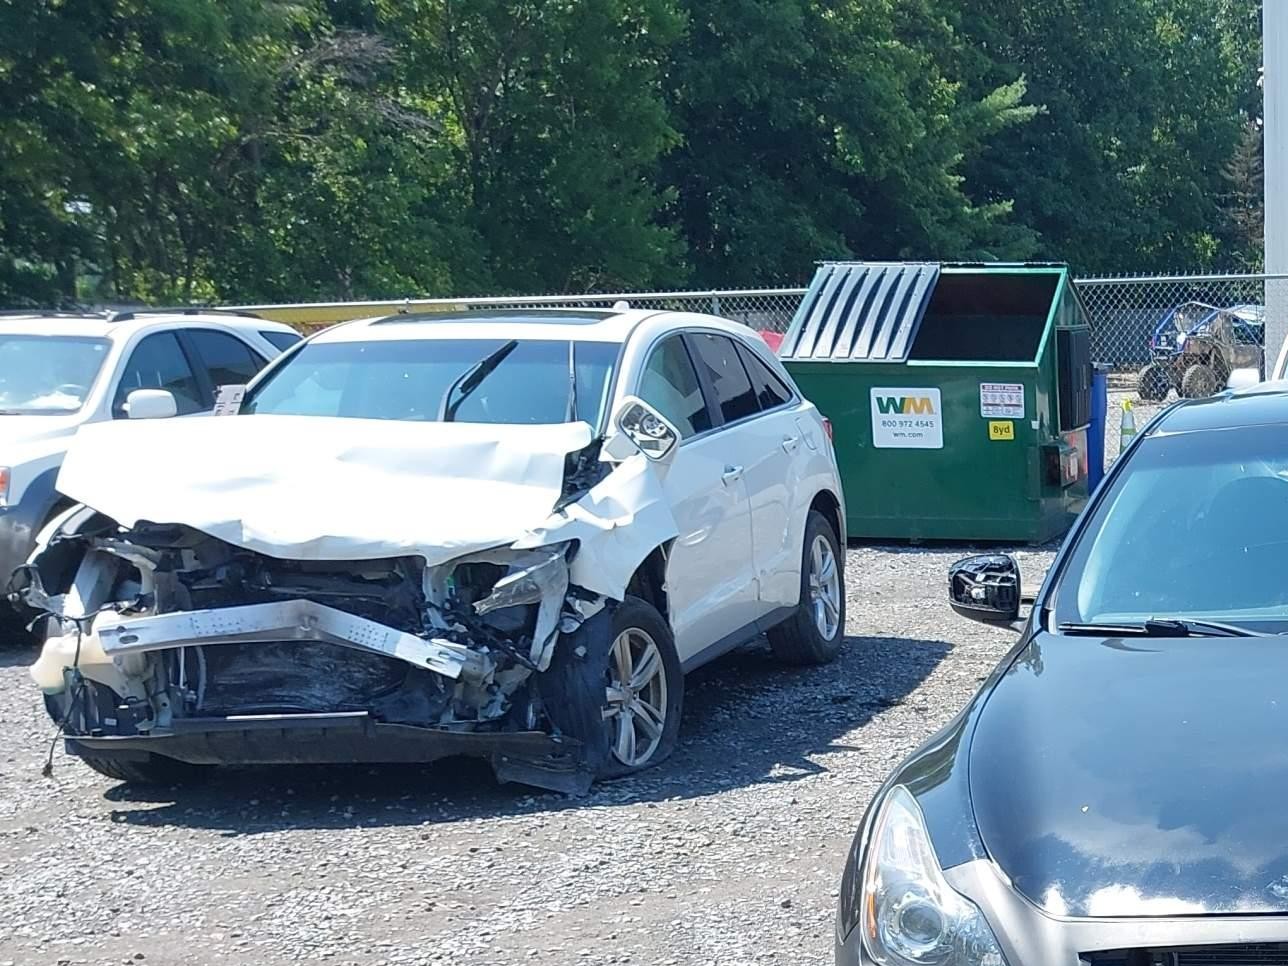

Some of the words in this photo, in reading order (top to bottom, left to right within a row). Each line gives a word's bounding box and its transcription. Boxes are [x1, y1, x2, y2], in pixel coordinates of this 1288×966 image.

[875, 397, 935, 415] WM
[881, 420, 897, 428] 800
[898, 420, 913, 428] 972
[914, 420, 935, 428] 4545
[993, 425, 1011, 436] 8yd
